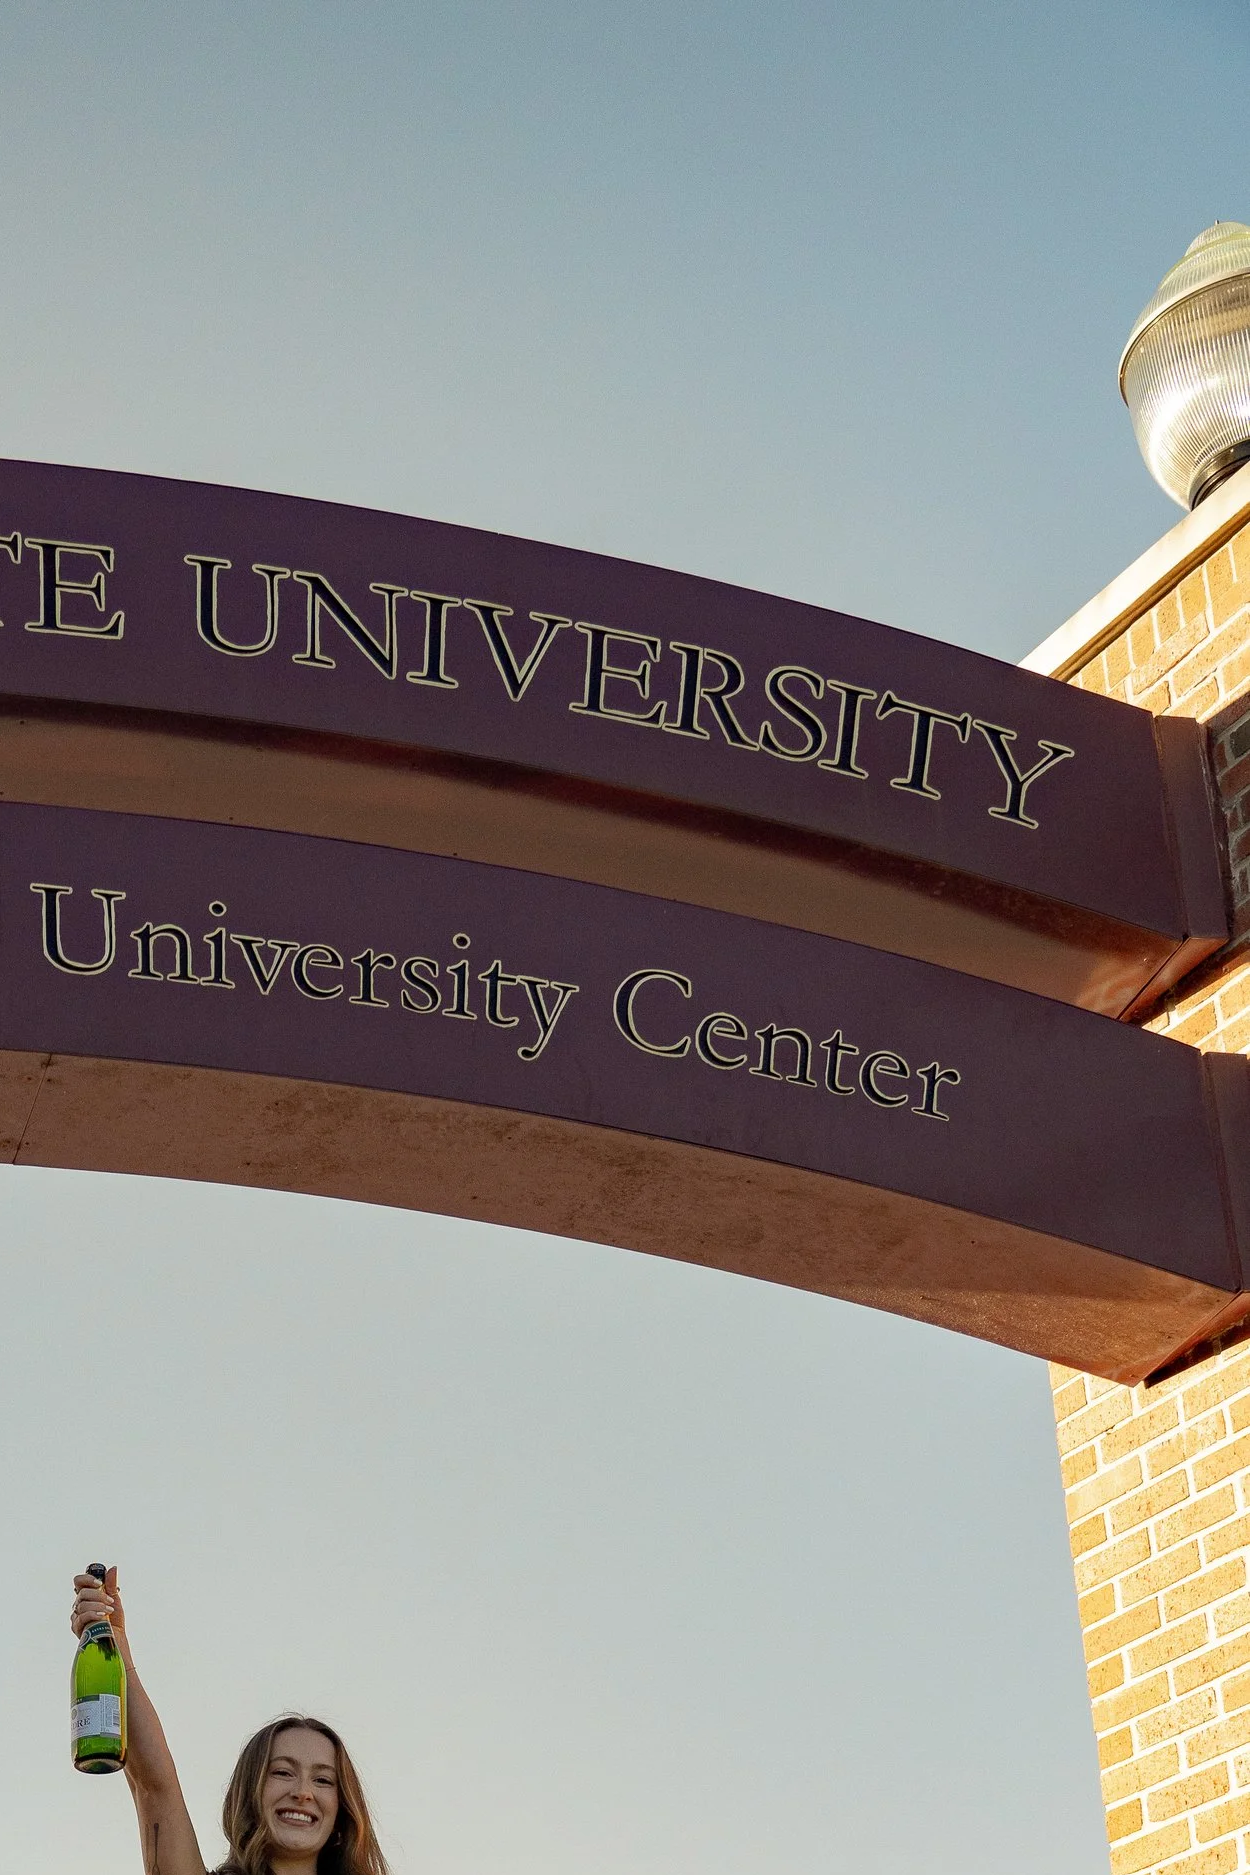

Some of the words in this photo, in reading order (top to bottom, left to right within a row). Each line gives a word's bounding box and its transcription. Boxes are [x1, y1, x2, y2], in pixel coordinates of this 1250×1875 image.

[183, 553, 1075, 830] UNIVERSITY
[29, 882, 580, 1062] University
[612, 968, 962, 1122] Center
